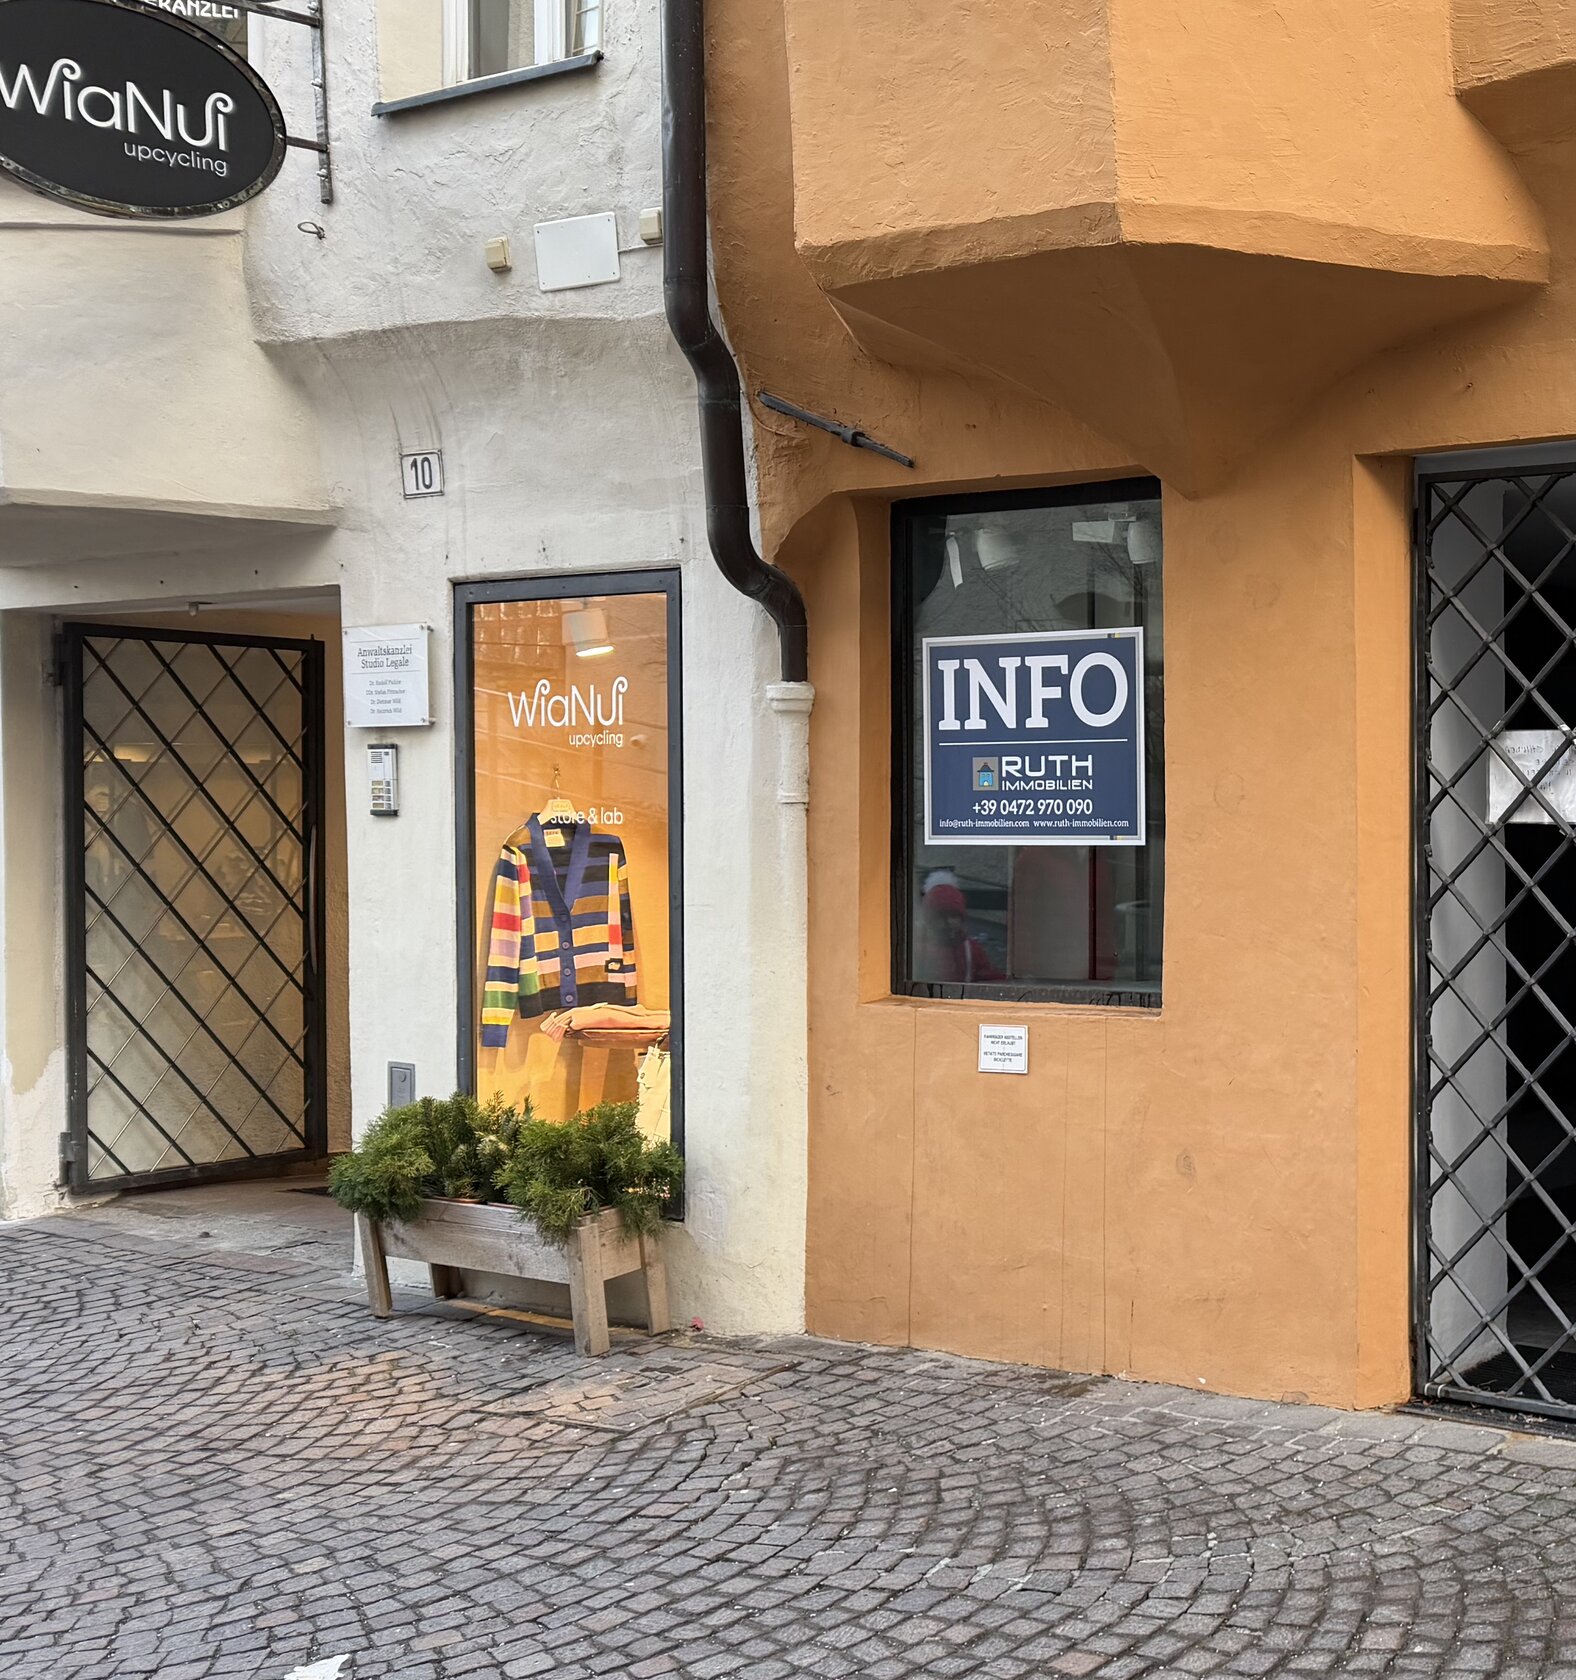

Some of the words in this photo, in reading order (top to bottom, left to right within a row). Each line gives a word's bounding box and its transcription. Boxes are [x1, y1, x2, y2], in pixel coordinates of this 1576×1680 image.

[124, 141, 228, 177] upcycling
[411, 457, 432, 490] 10
[358, 644, 412, 657] Anwaltskanzlei
[361, 658, 384, 669] Studio
[386, 656, 409, 669] Legale
[937, 652, 1128, 730] INFO
[569, 730, 623, 747] upcycling
[1002, 754, 1093, 777] RUTH
[1002, 779, 1093, 791] IMMOBILIEN
[588, 808, 599, 824] &
[601, 807, 624, 824] lab
[972, 799, 997, 815] +39
[1000, 799, 1035, 815] 0472
[1037, 799, 1064, 815] 970
[1066, 799, 1093, 815] 090
[939, 818, 1030, 828] info@ruth-immobilien.com
[1033, 818, 1129, 828] www.ruth-immobilien.com
